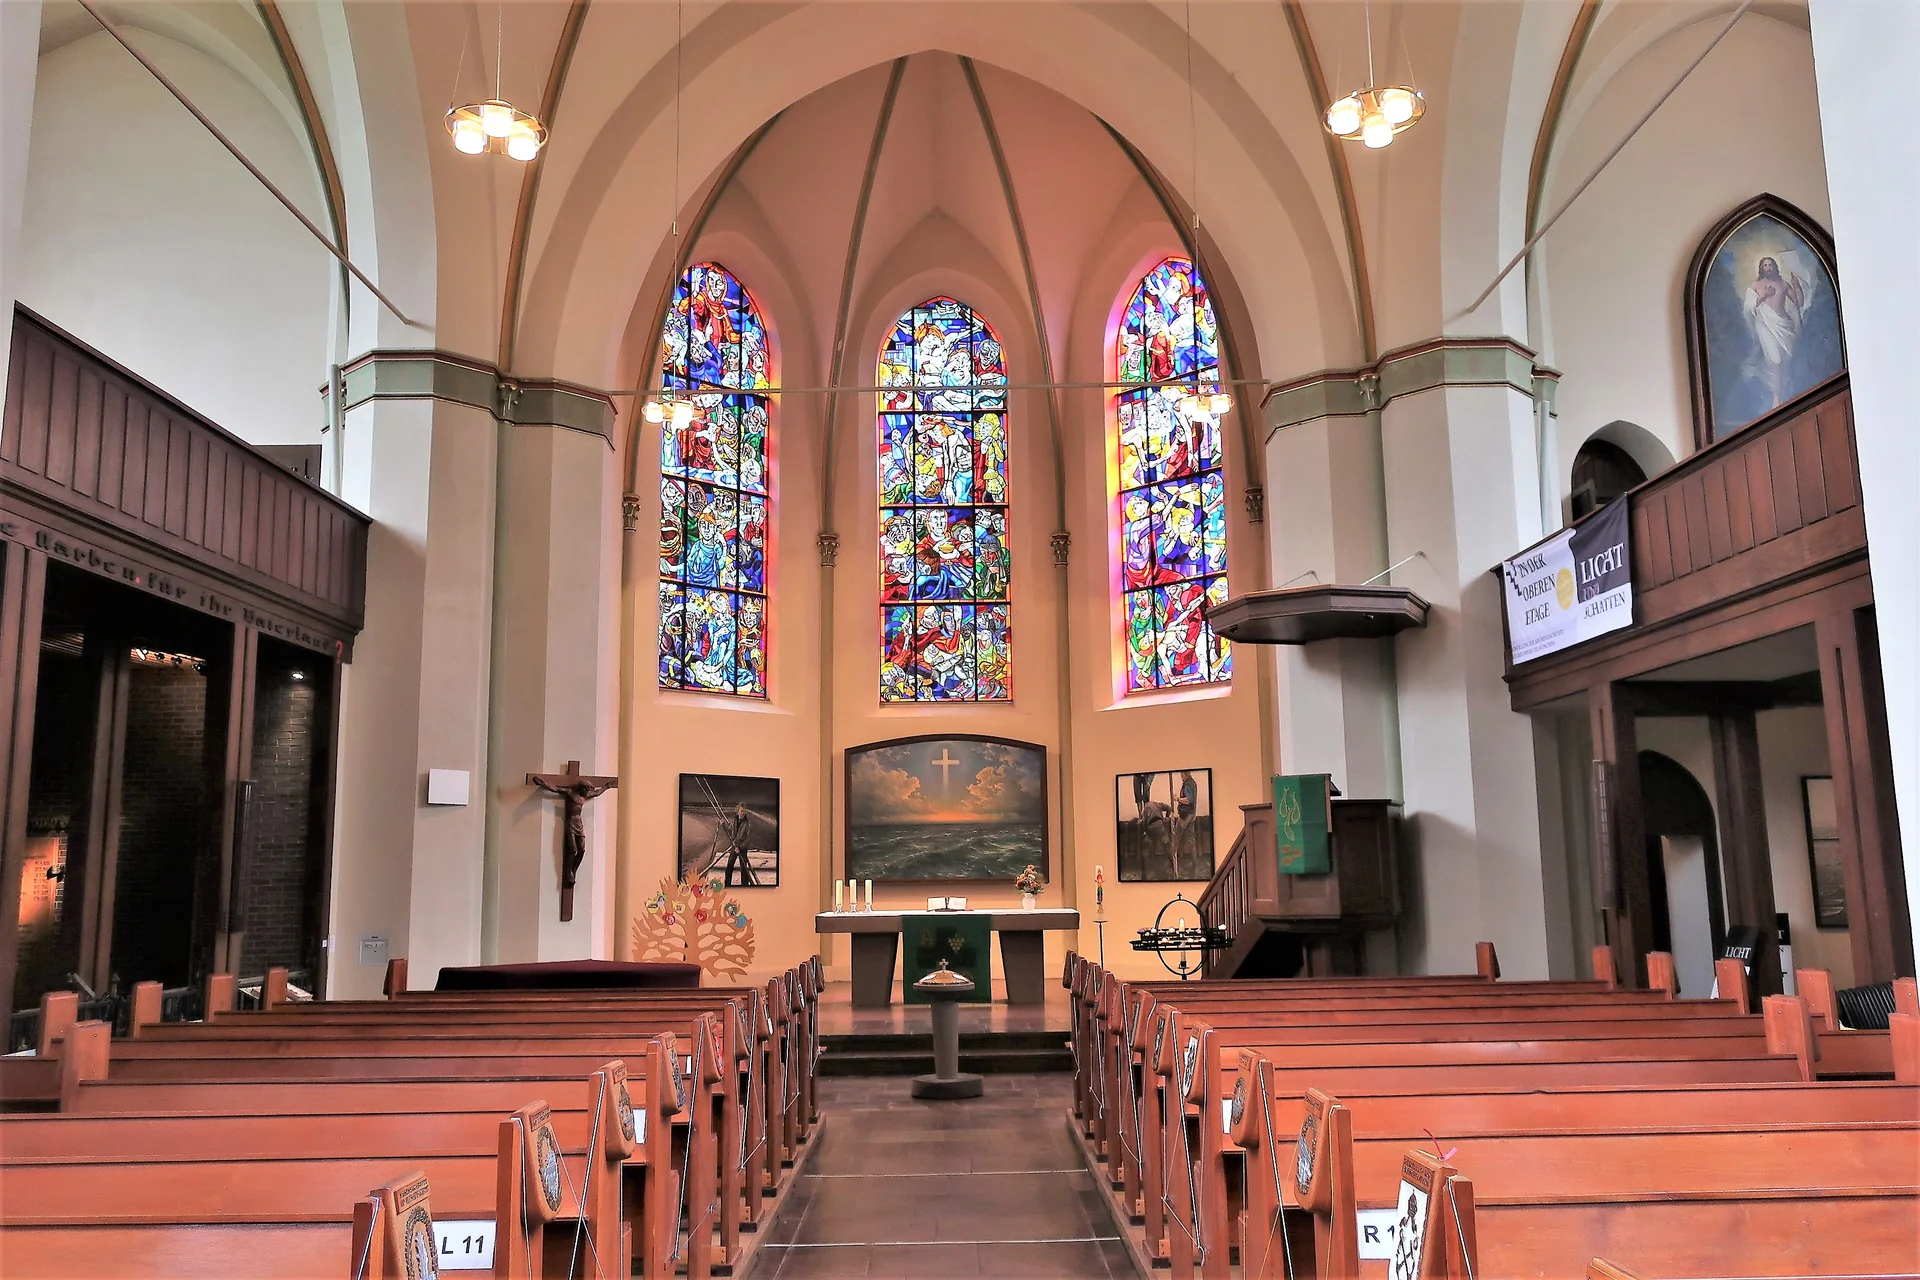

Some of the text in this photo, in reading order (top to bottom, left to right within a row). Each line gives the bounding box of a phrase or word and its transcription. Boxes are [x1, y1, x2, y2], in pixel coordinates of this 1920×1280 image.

[1527, 553, 1547, 572] DER
[1523, 573, 1556, 602] OBEREN
[1525, 602, 1551, 626] ETAGE
[1725, 946, 1752, 959] LICHT
[1363, 1225, 1381, 1243] R
[441, 1235, 485, 1255] L 11
